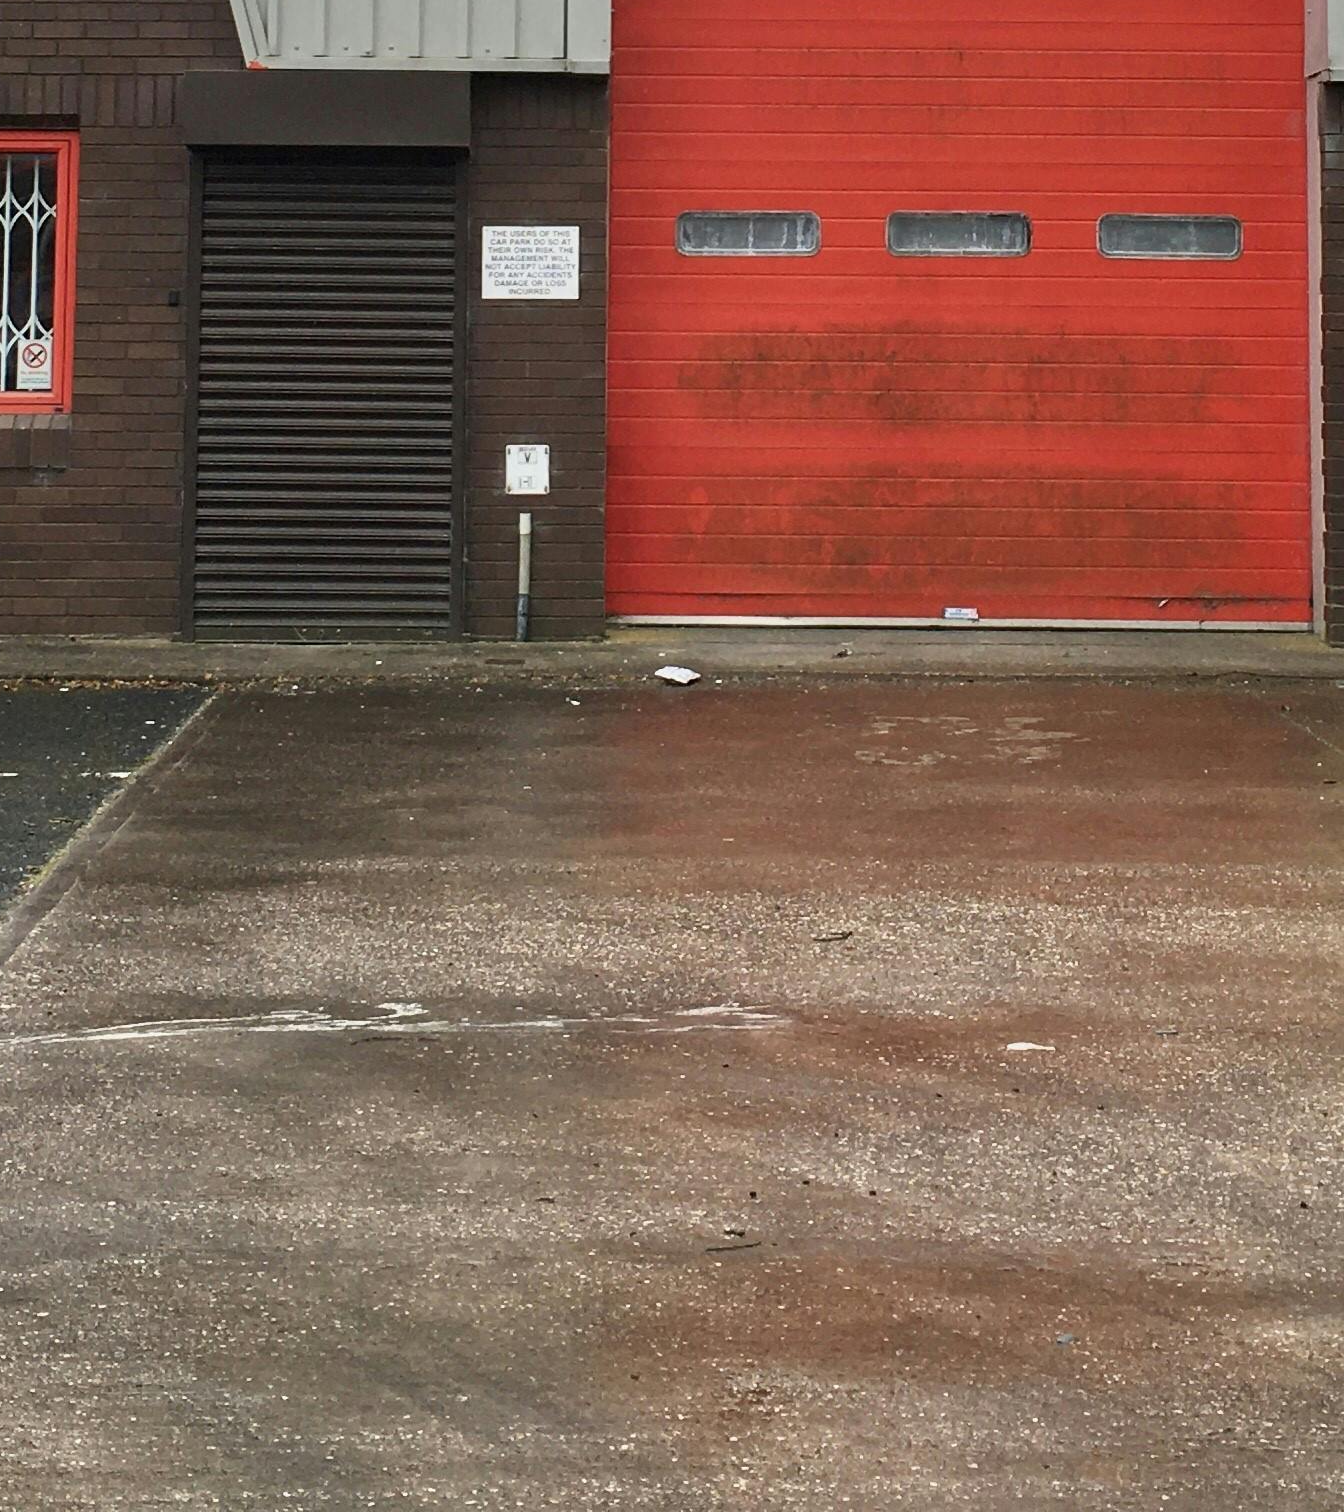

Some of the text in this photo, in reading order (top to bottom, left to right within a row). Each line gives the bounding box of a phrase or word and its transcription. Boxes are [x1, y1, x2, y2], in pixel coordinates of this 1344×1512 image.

[488, 246, 511, 254] THEIR
[514, 246, 533, 254] OWN
[559, 246, 574, 254] THE
[488, 271, 505, 279] FOR
[508, 271, 525, 279] ANY
[494, 279, 567, 287] DAMAGE OR LOSS
